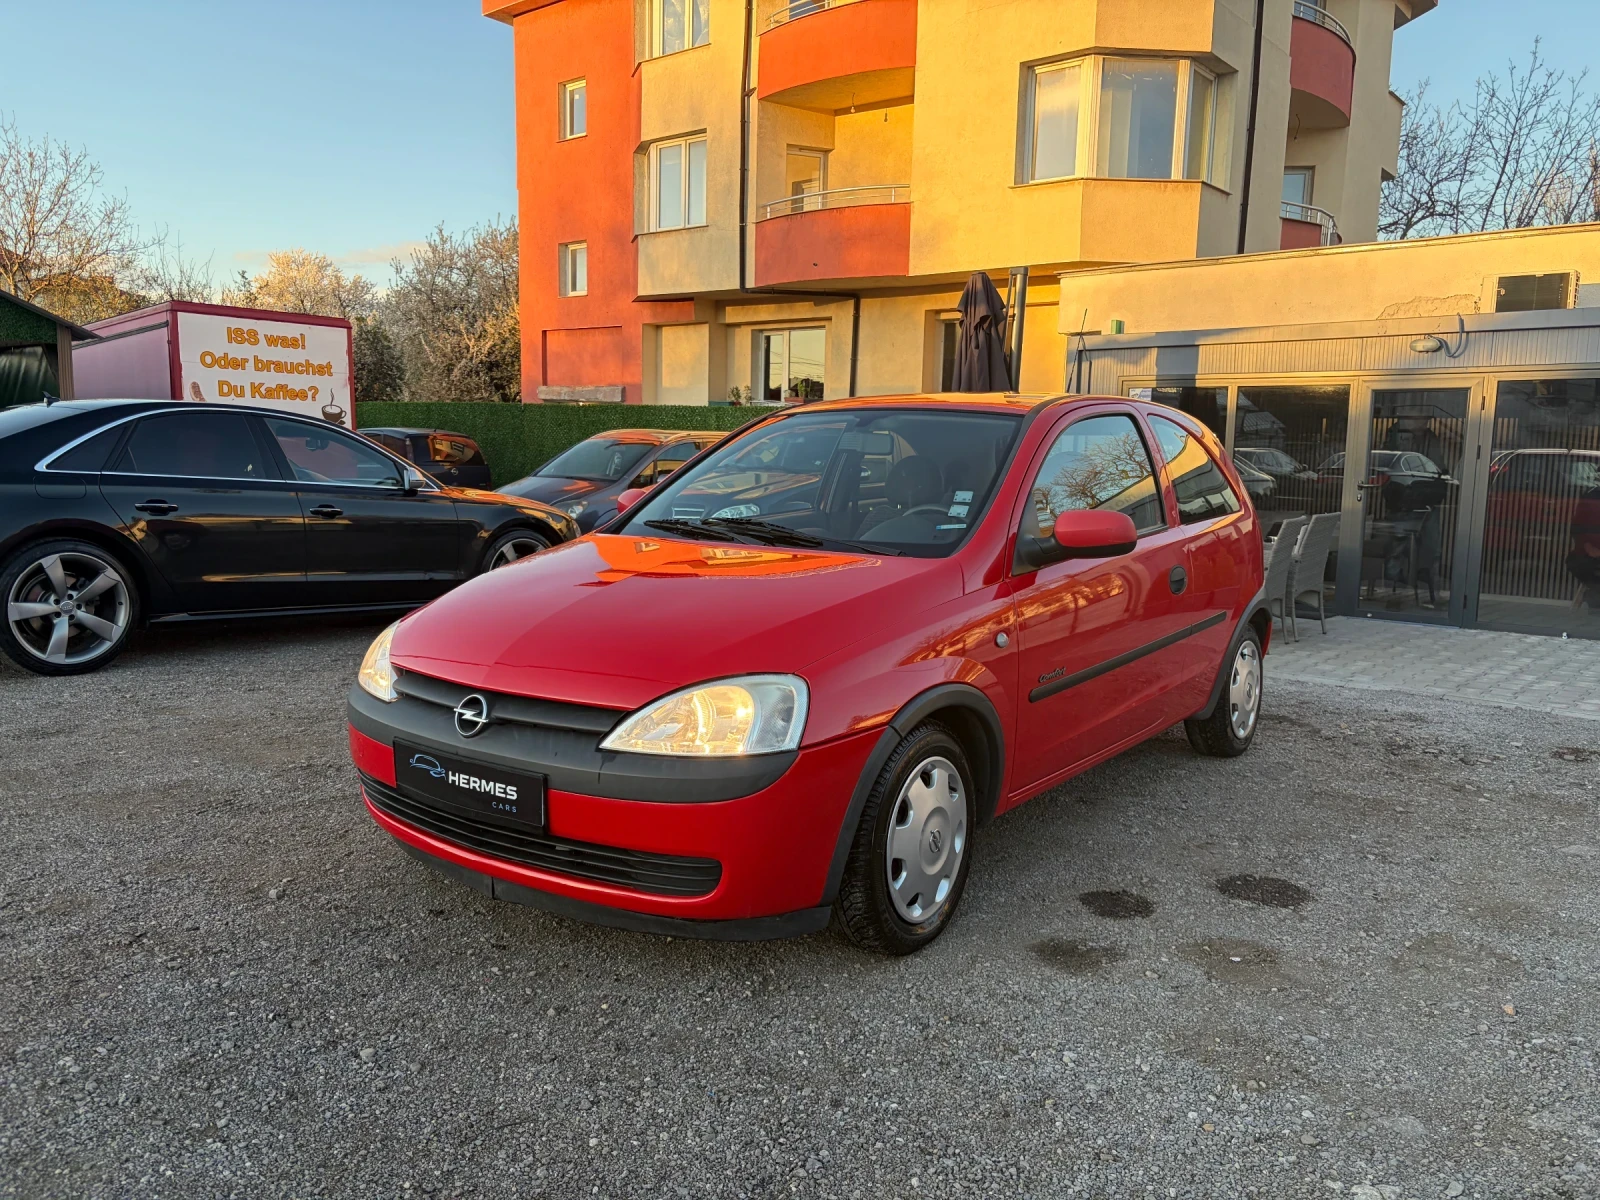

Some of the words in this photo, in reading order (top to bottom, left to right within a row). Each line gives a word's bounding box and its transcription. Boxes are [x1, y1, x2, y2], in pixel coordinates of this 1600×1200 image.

[226, 327, 260, 346] ISS
[263, 333, 306, 350] was!
[199, 350, 249, 370] Oder
[253, 355, 333, 377] brauchst
[217, 380, 246, 398] Du
[250, 382, 320, 401] Kaffee?
[448, 771, 518, 801] HERMES
[491, 801, 517, 813] CARS
